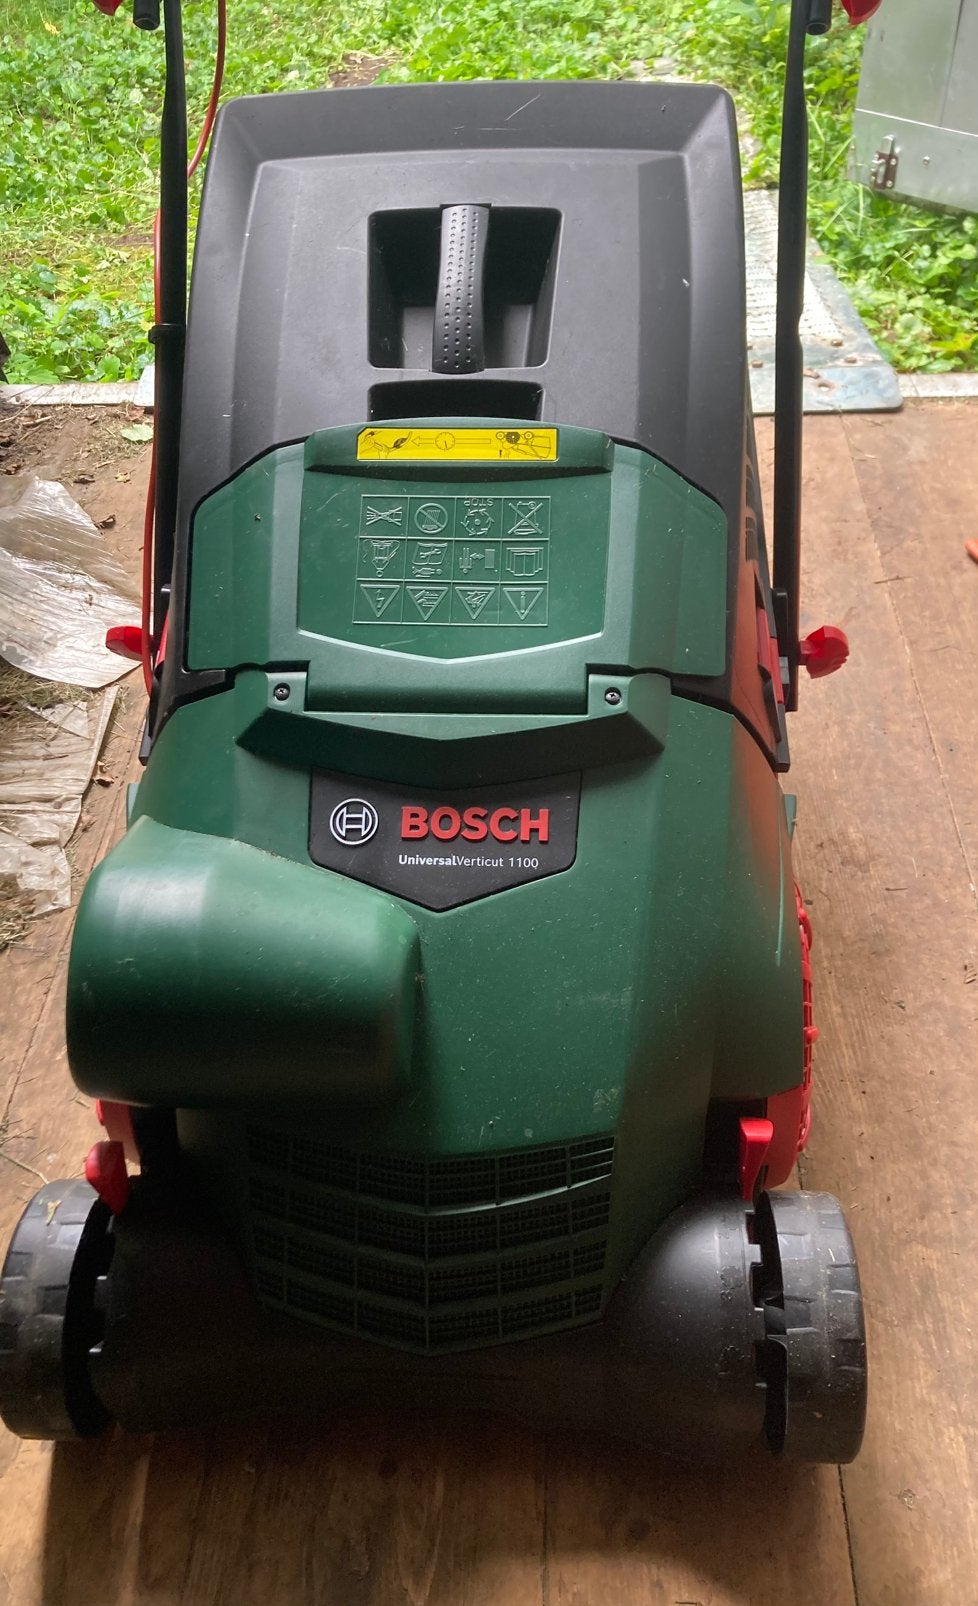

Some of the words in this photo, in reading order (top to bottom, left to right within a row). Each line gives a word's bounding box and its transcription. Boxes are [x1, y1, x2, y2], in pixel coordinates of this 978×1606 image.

[401, 806, 549, 842] BOSCH
[398, 854, 503, 867] UniversalVerticut
[509, 857, 539, 869] 1100
